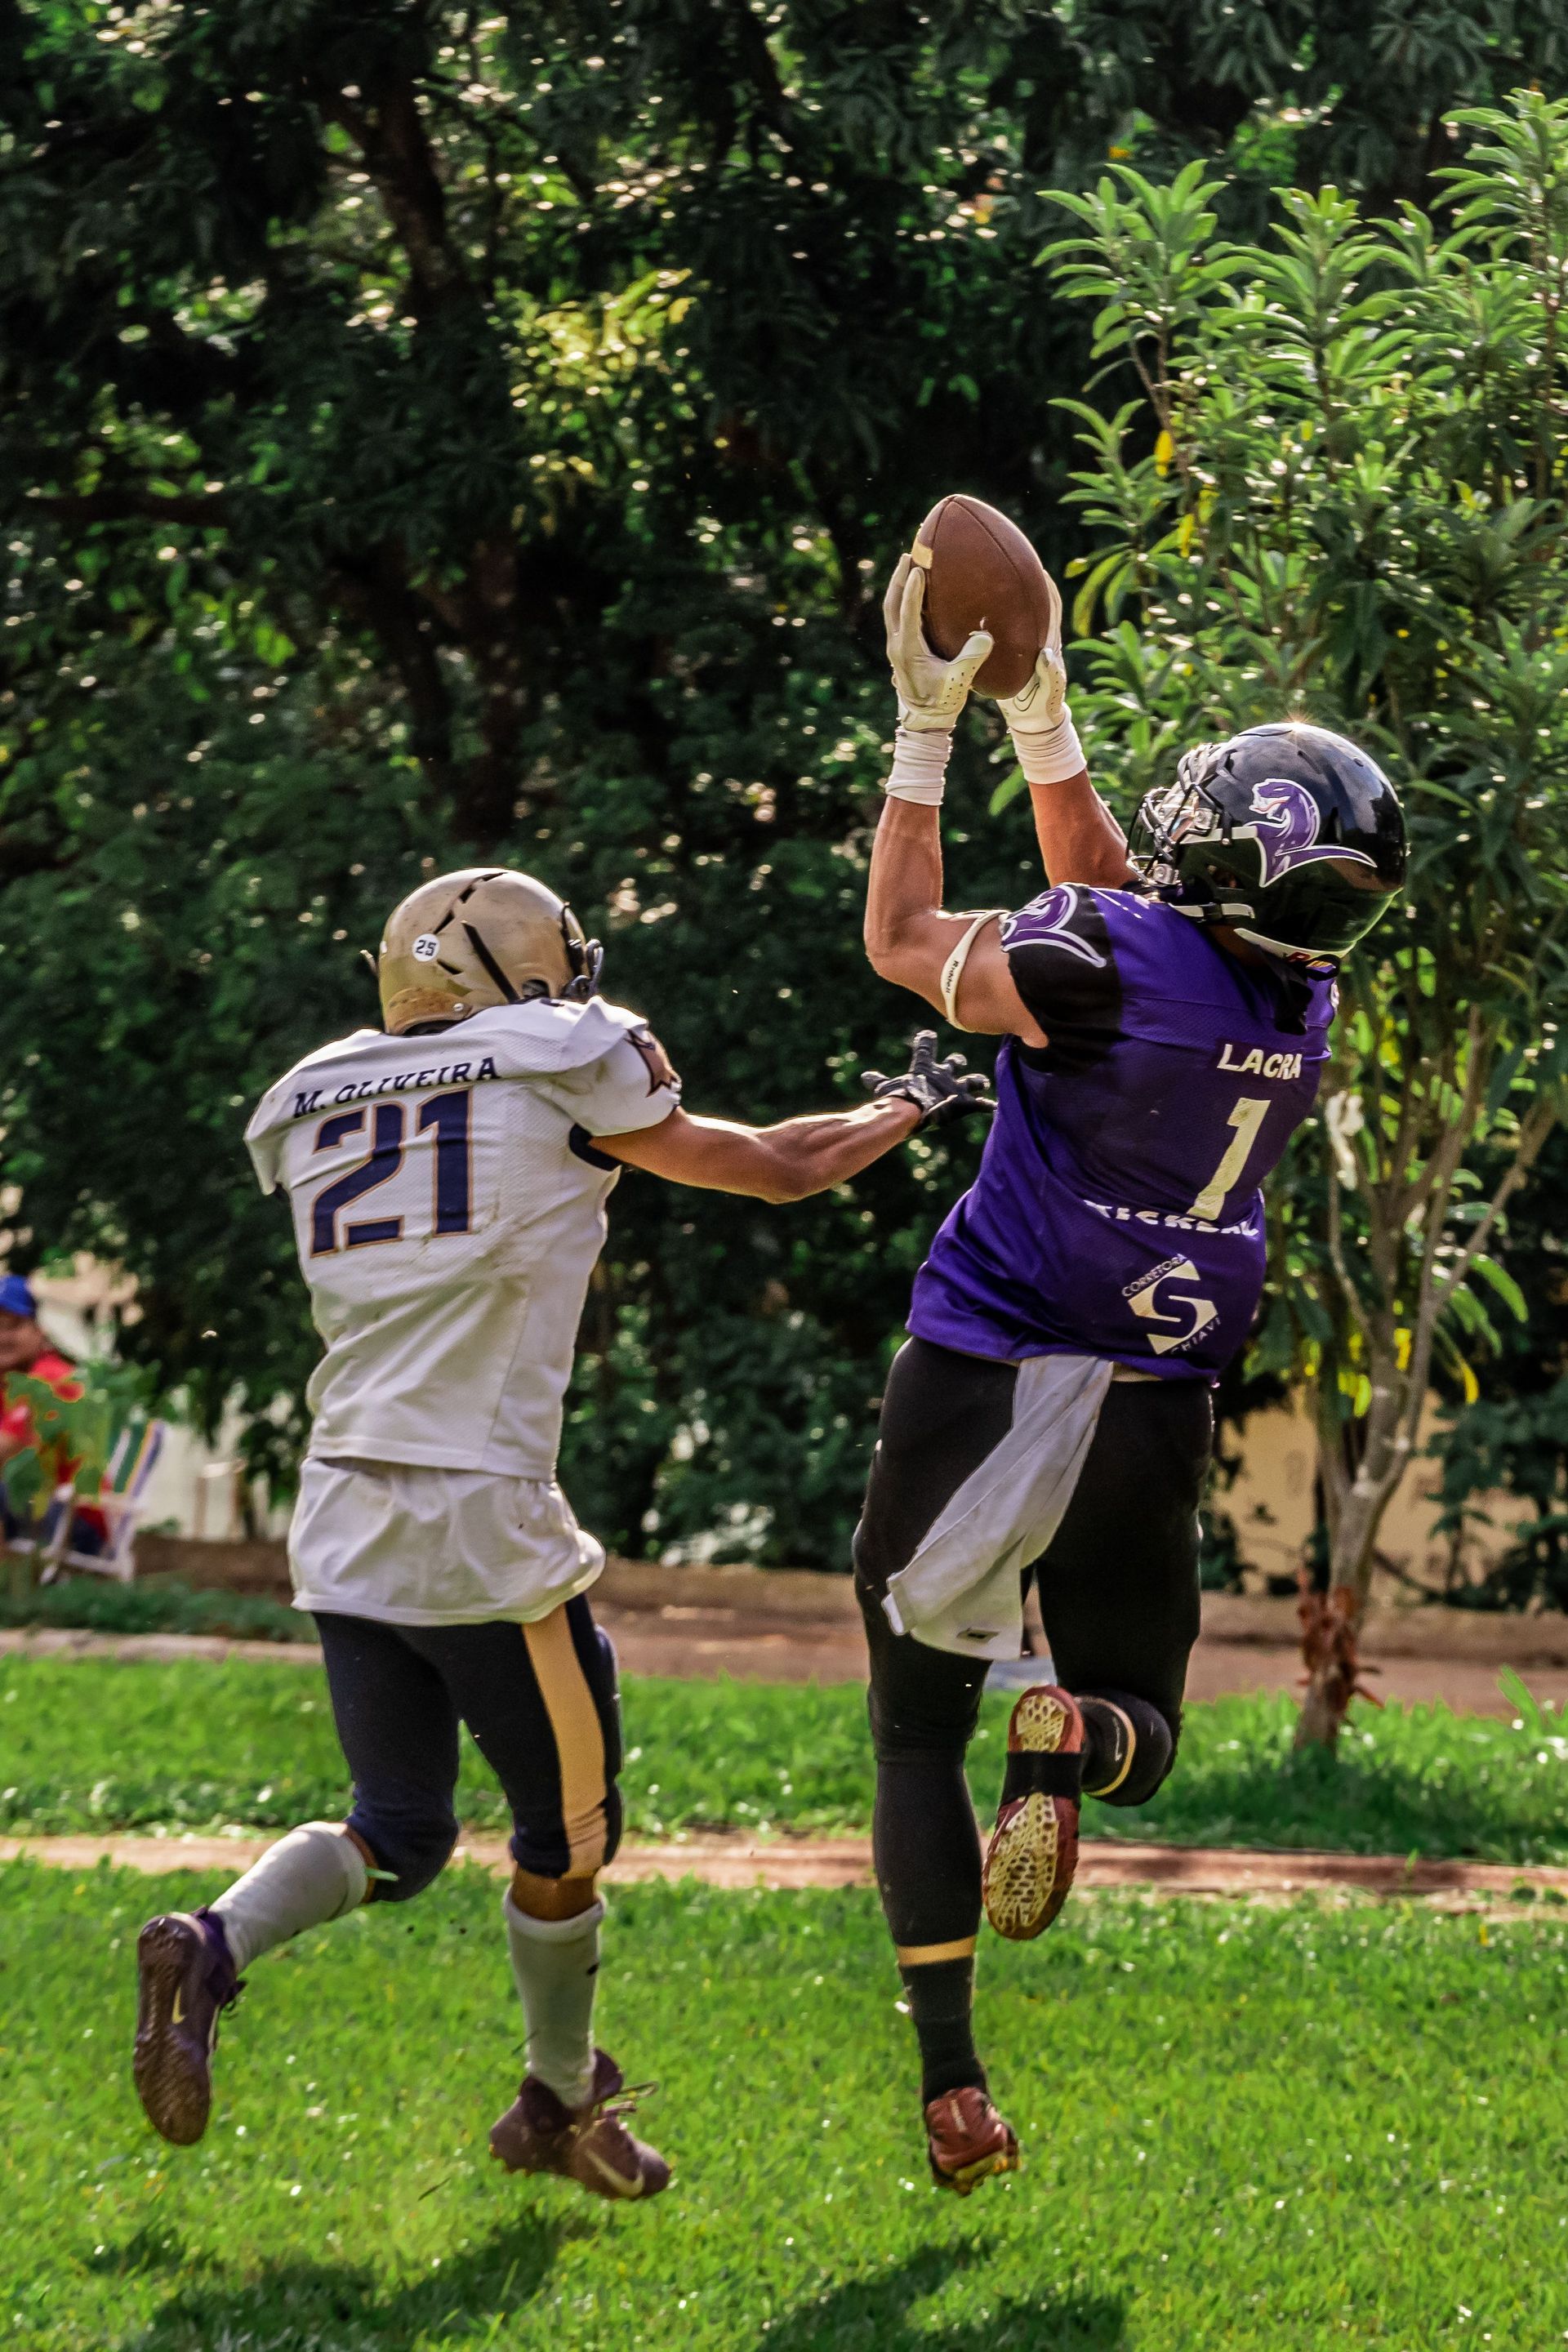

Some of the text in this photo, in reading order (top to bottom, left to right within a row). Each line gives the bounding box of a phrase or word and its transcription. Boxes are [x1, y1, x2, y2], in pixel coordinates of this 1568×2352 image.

[415, 939, 437, 957] 25
[293, 1057, 501, 1118] M. OLIVEIRA
[1217, 1044, 1303, 1080] LACRA
[310, 1085, 474, 1258] 21
[1187, 1097, 1271, 1221] 1
